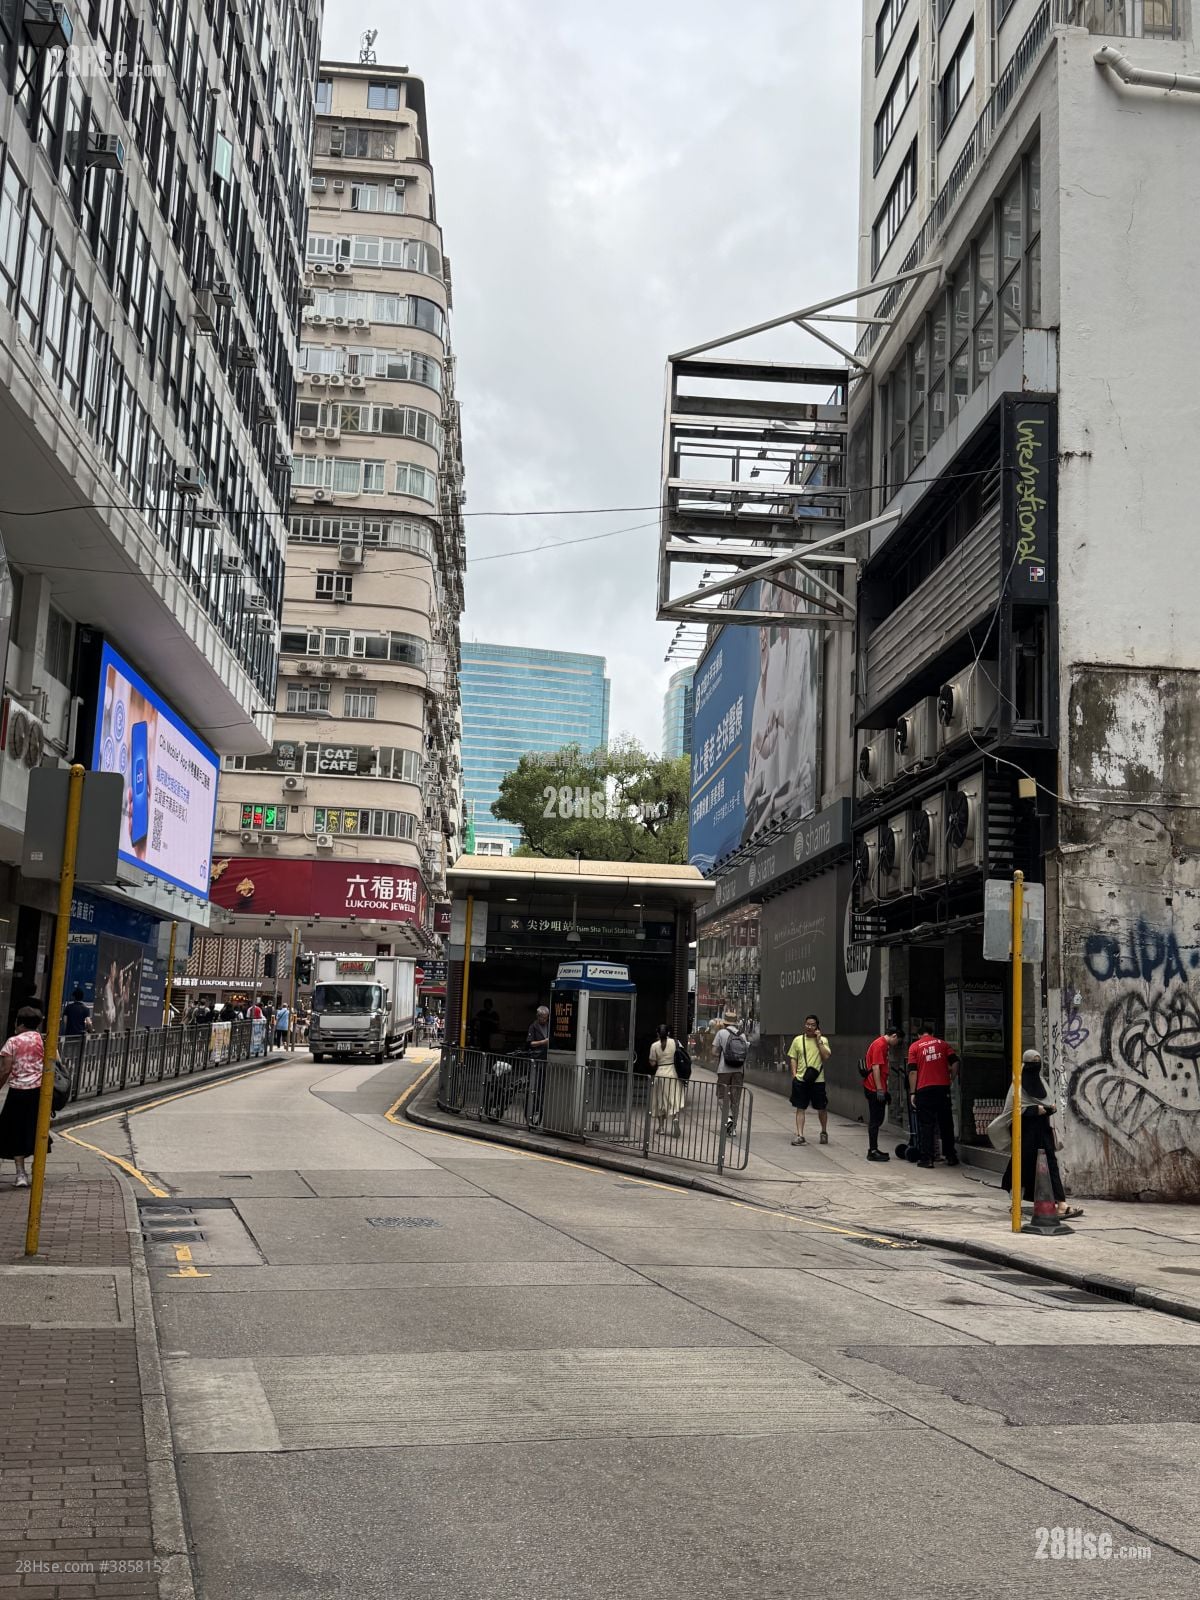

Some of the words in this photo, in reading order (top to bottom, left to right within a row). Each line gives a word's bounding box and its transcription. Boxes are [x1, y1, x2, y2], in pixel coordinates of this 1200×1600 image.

[324, 748, 353, 759] CAT
[319, 760, 357, 772] CAFE
[805, 820, 831, 856] shama
[345, 899, 389, 910] LUKFOOK
[576, 925, 587, 934] Tsim
[587, 926, 601, 934] Sha
[602, 926, 614, 934] Tsui
[614, 927, 635, 935] Station
[780, 966, 817, 989] GIORDANO
